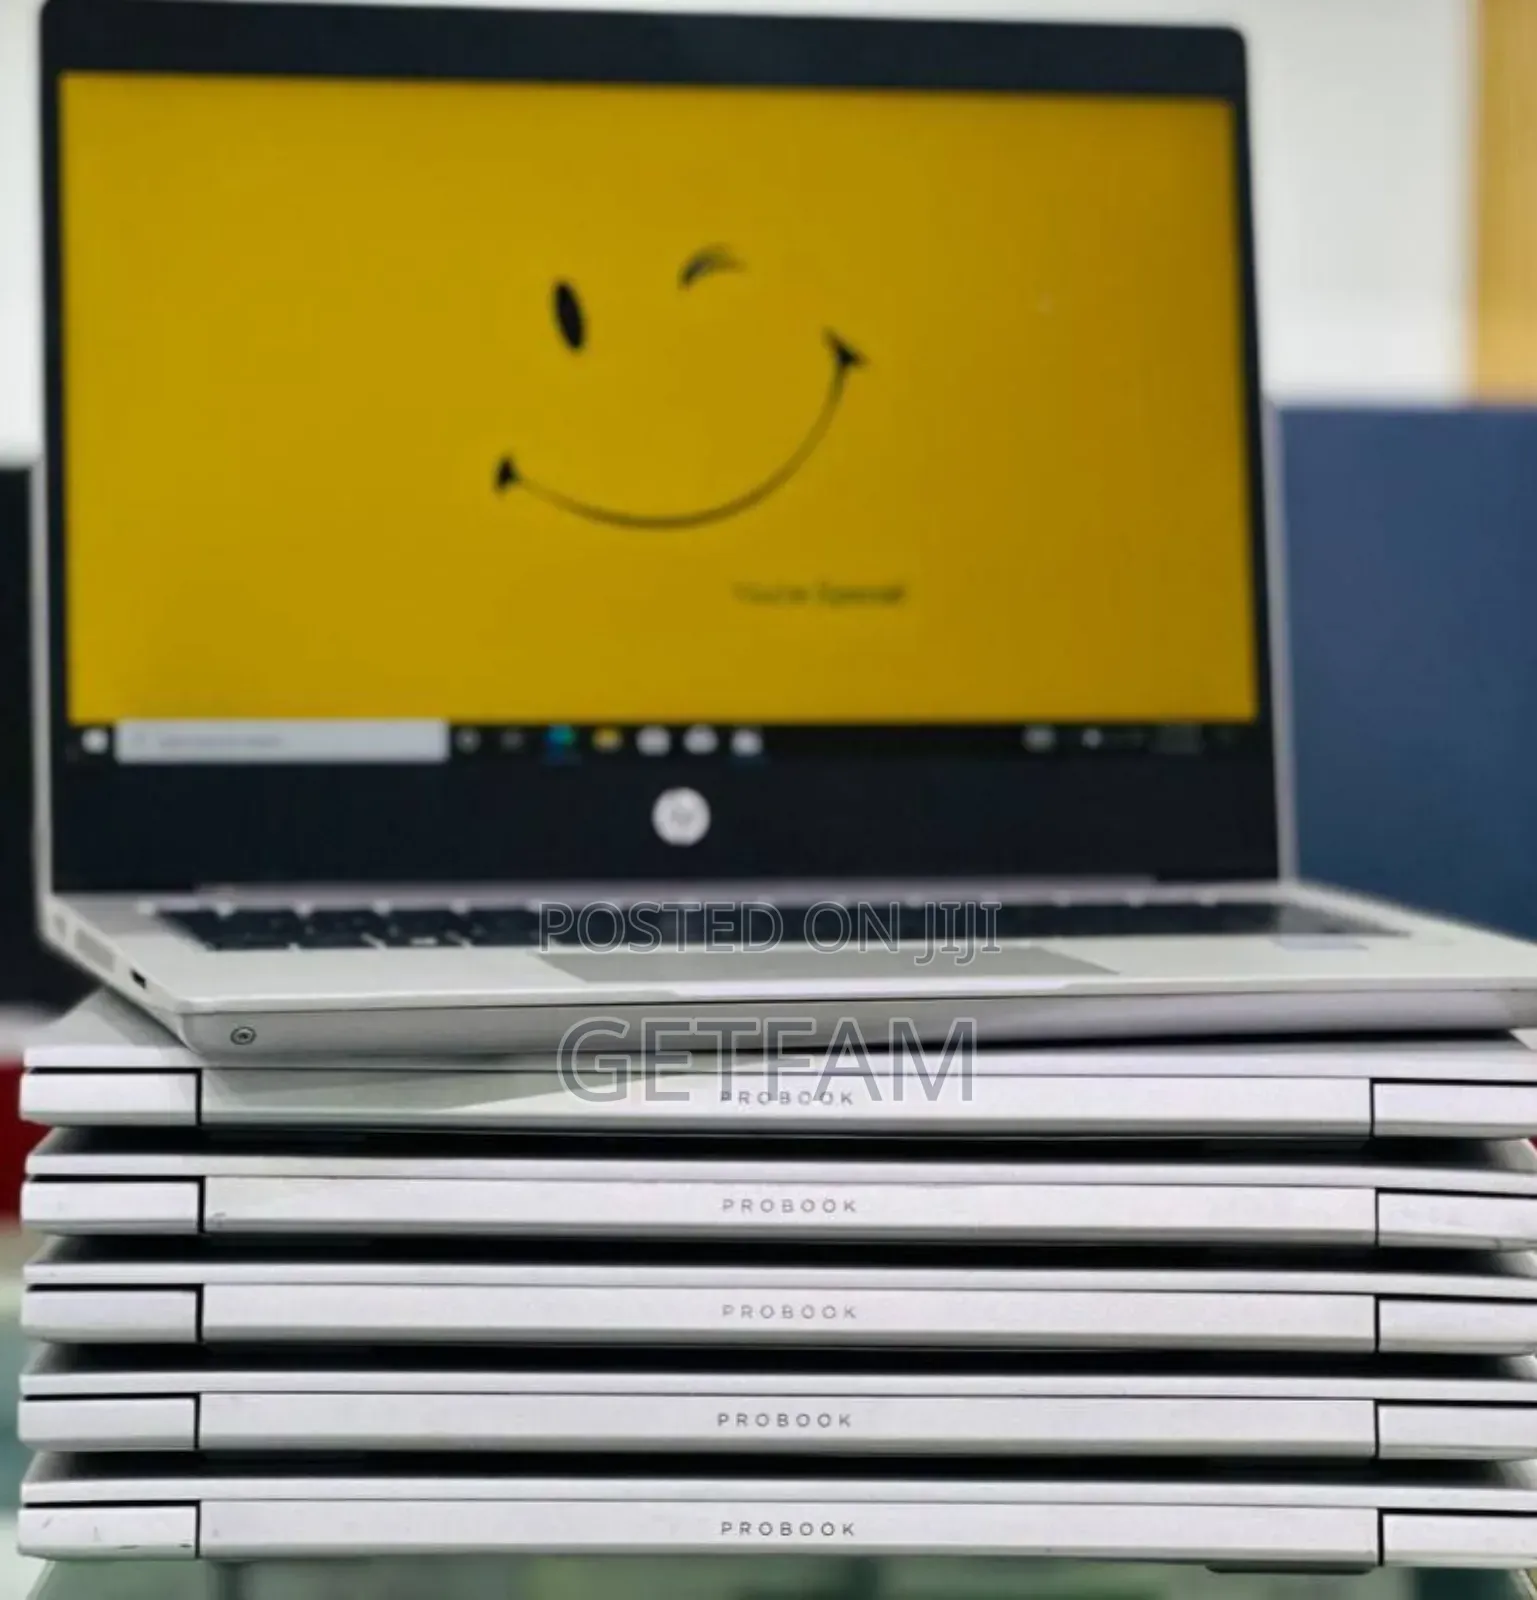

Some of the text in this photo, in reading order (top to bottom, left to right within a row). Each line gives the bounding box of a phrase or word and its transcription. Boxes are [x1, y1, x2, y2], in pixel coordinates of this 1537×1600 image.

[720, 1091, 853, 1105] PROBOOK
[722, 1199, 856, 1214] PROBOOK
[722, 1304, 856, 1319] PROBOOK
[717, 1412, 851, 1428] PROBOOK
[721, 1521, 854, 1536] PROBOOK
